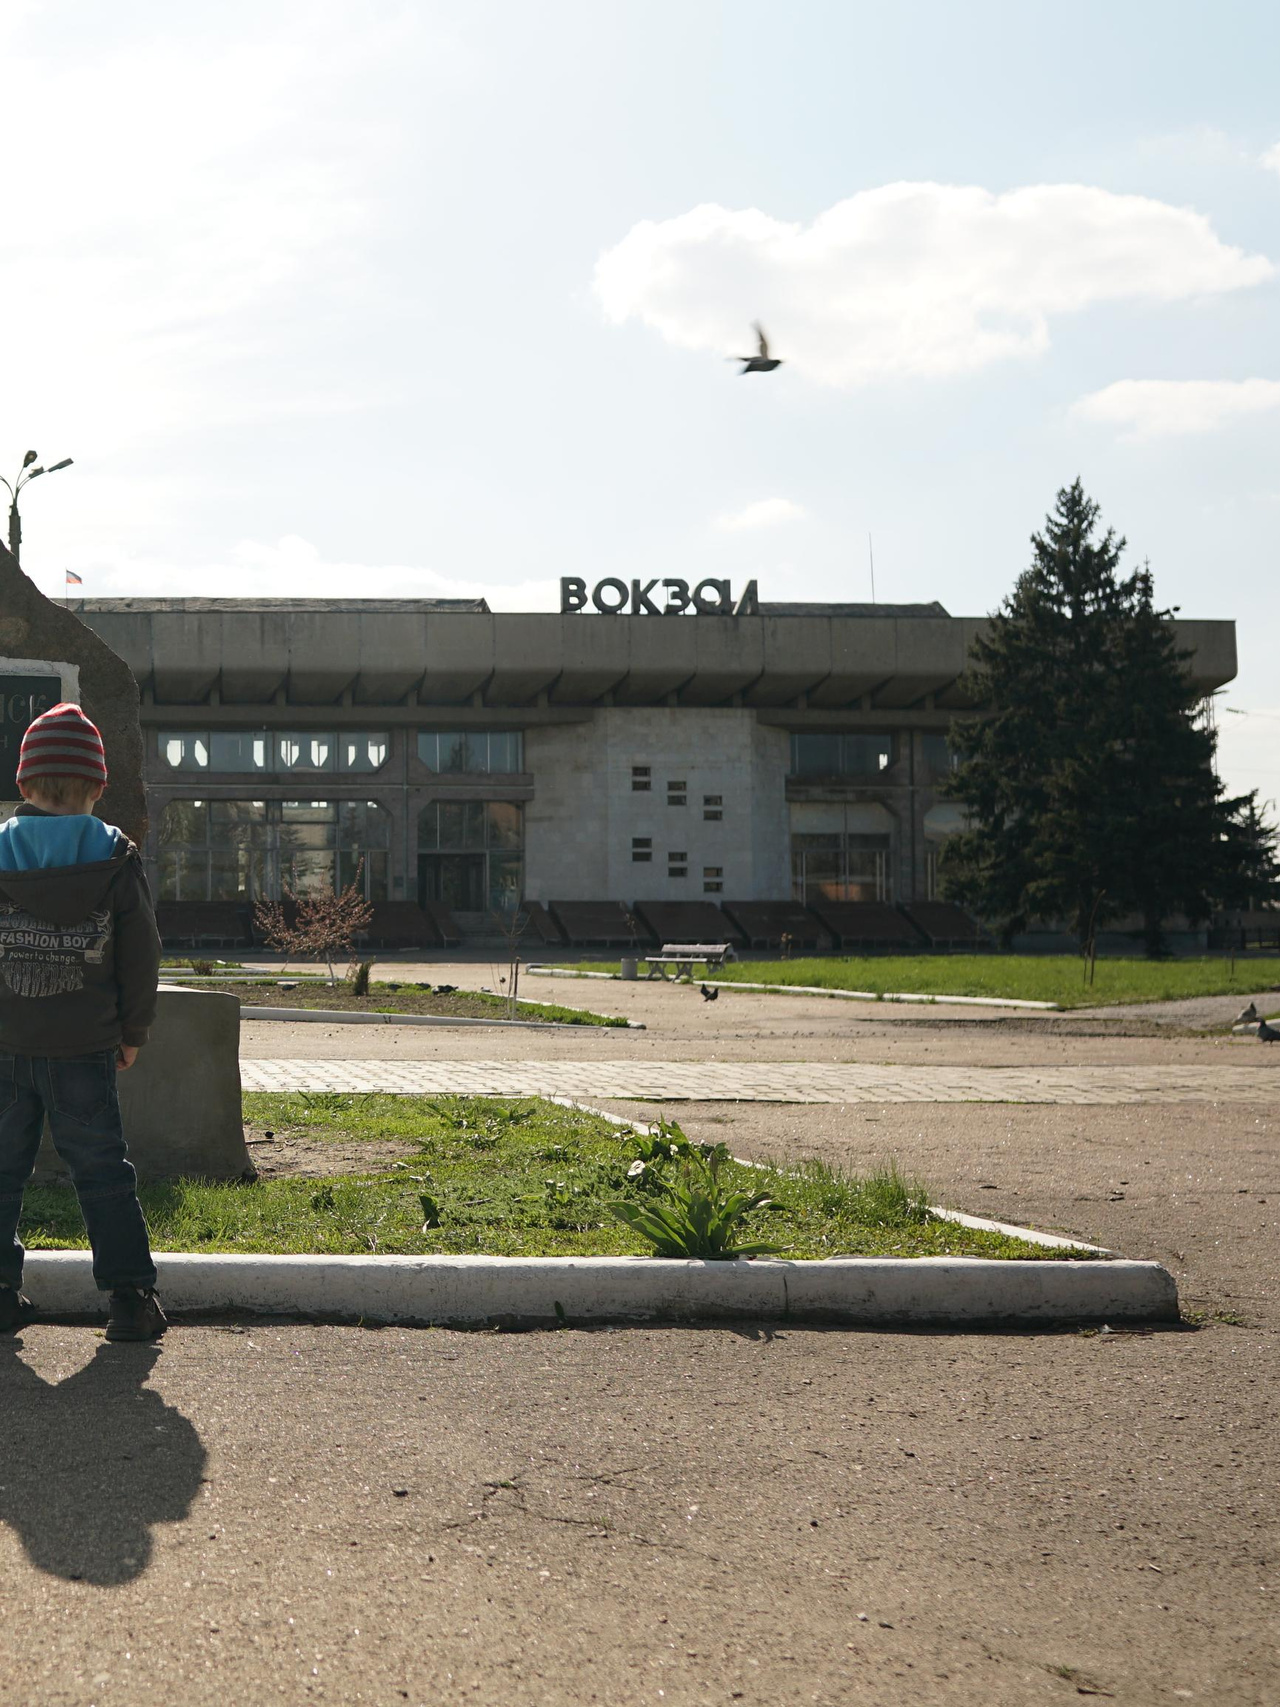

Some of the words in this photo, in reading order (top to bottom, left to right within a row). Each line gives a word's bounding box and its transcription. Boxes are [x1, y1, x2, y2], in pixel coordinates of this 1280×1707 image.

[0, 932, 60, 948] FASHION
[62, 936, 91, 949] BOY
[8, 951, 34, 961] power
[34, 951, 44, 961] to
